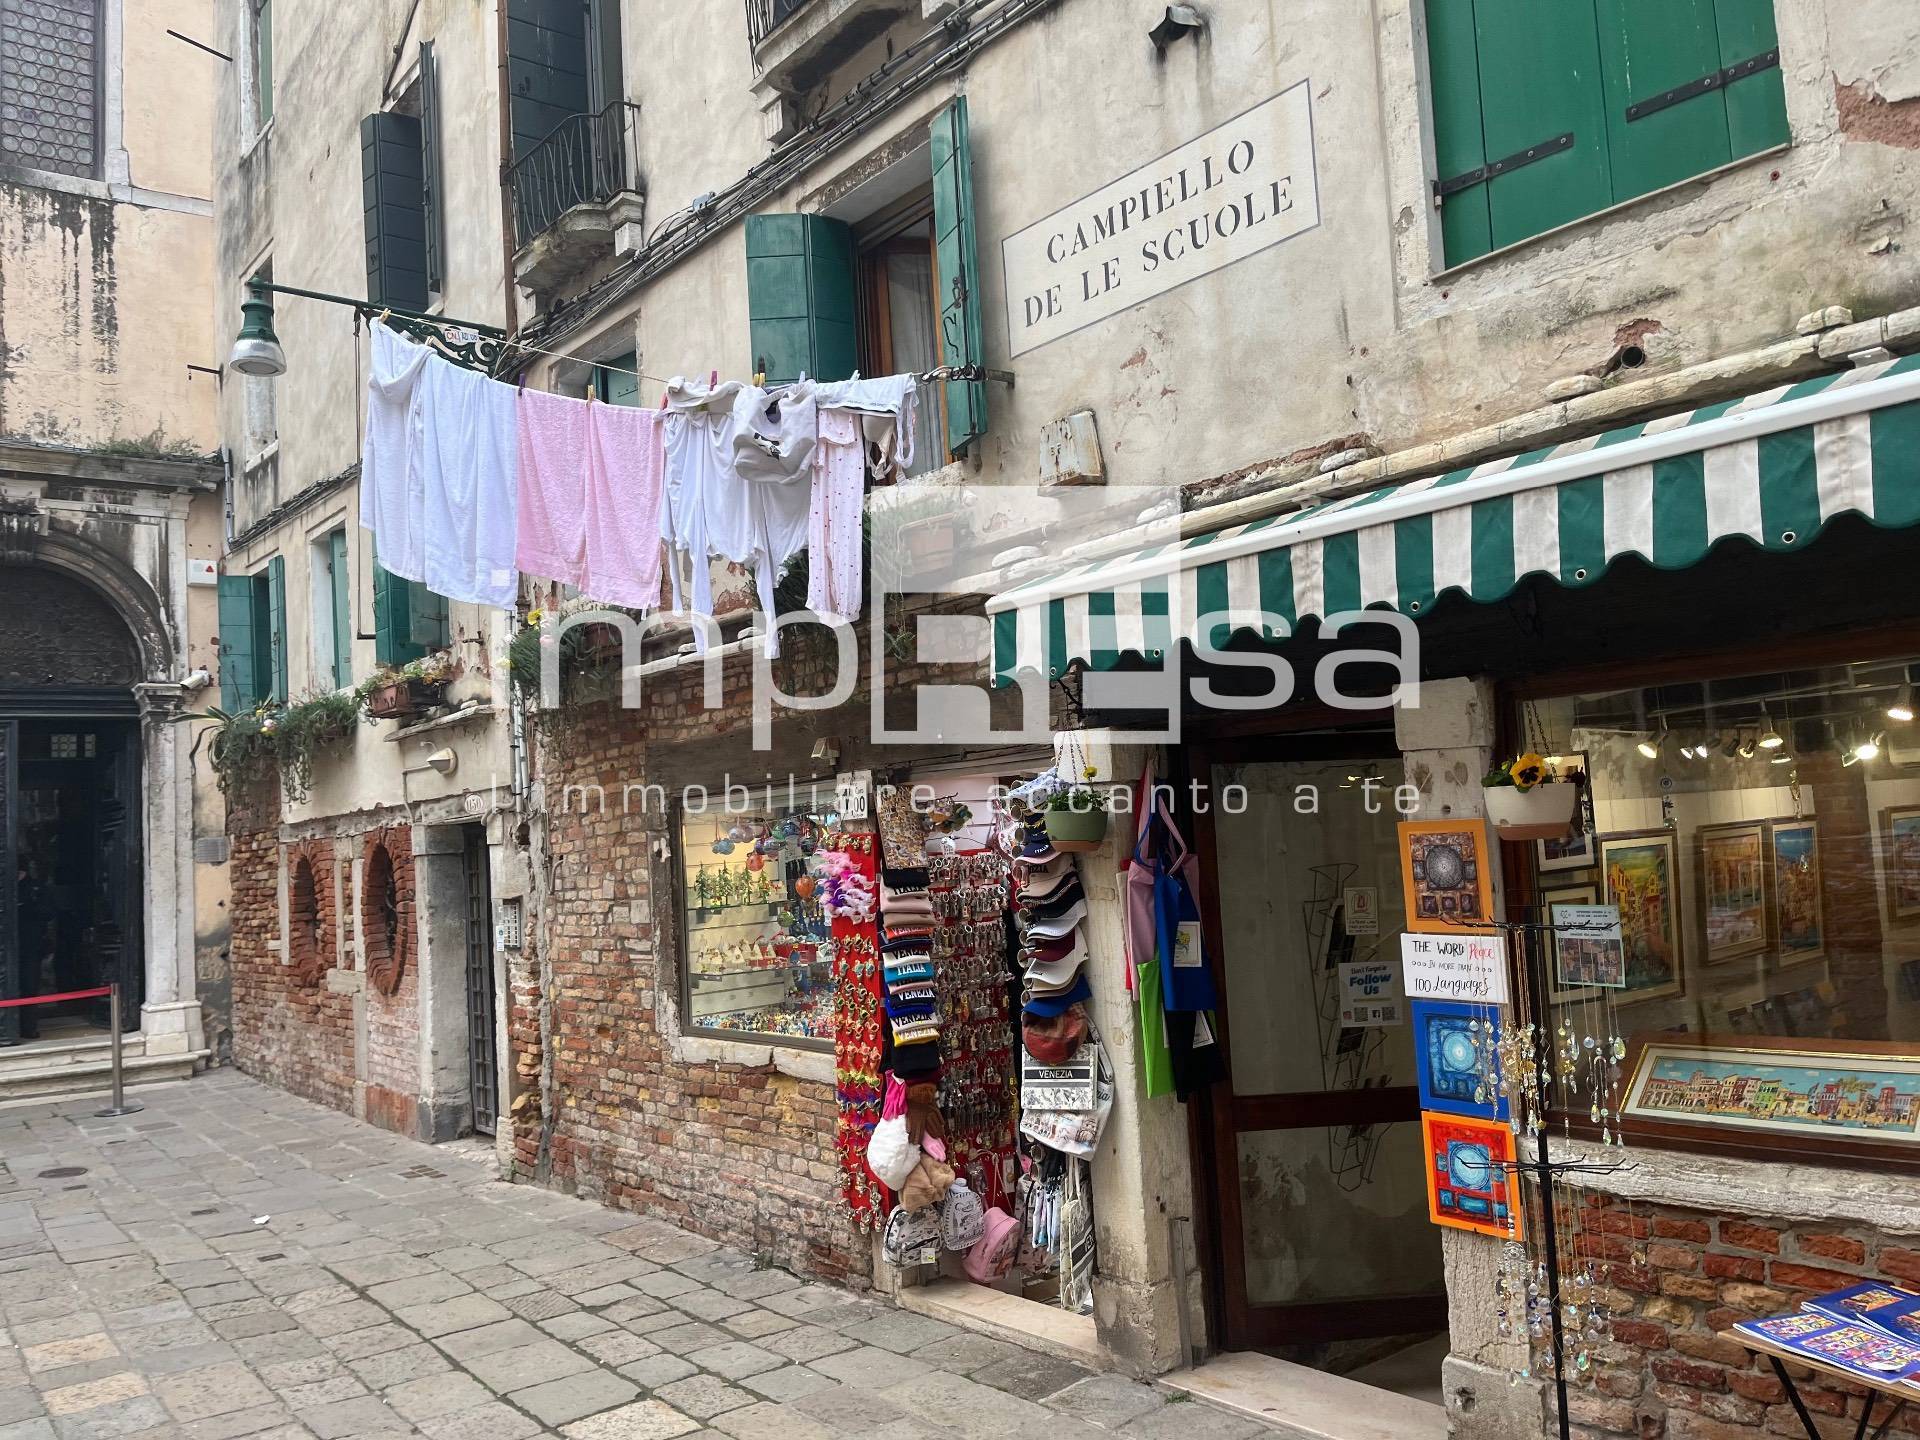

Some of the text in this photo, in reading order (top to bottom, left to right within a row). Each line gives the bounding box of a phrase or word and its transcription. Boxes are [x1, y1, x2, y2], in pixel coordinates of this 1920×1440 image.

[1047, 140, 1255, 264] CAMPIELLO
[1025, 176, 1294, 328] DE LE SCUOLE
[1412, 941, 1432, 953] THE
[1437, 941, 1465, 957] WORD
[897, 963, 927, 976] ITALIA
[1349, 974, 1392, 987] Follow
[1415, 976, 1489, 997] 100 Languages
[899, 987, 936, 1001] VENEZIA
[1039, 1069, 1074, 1079] VENEZIA
